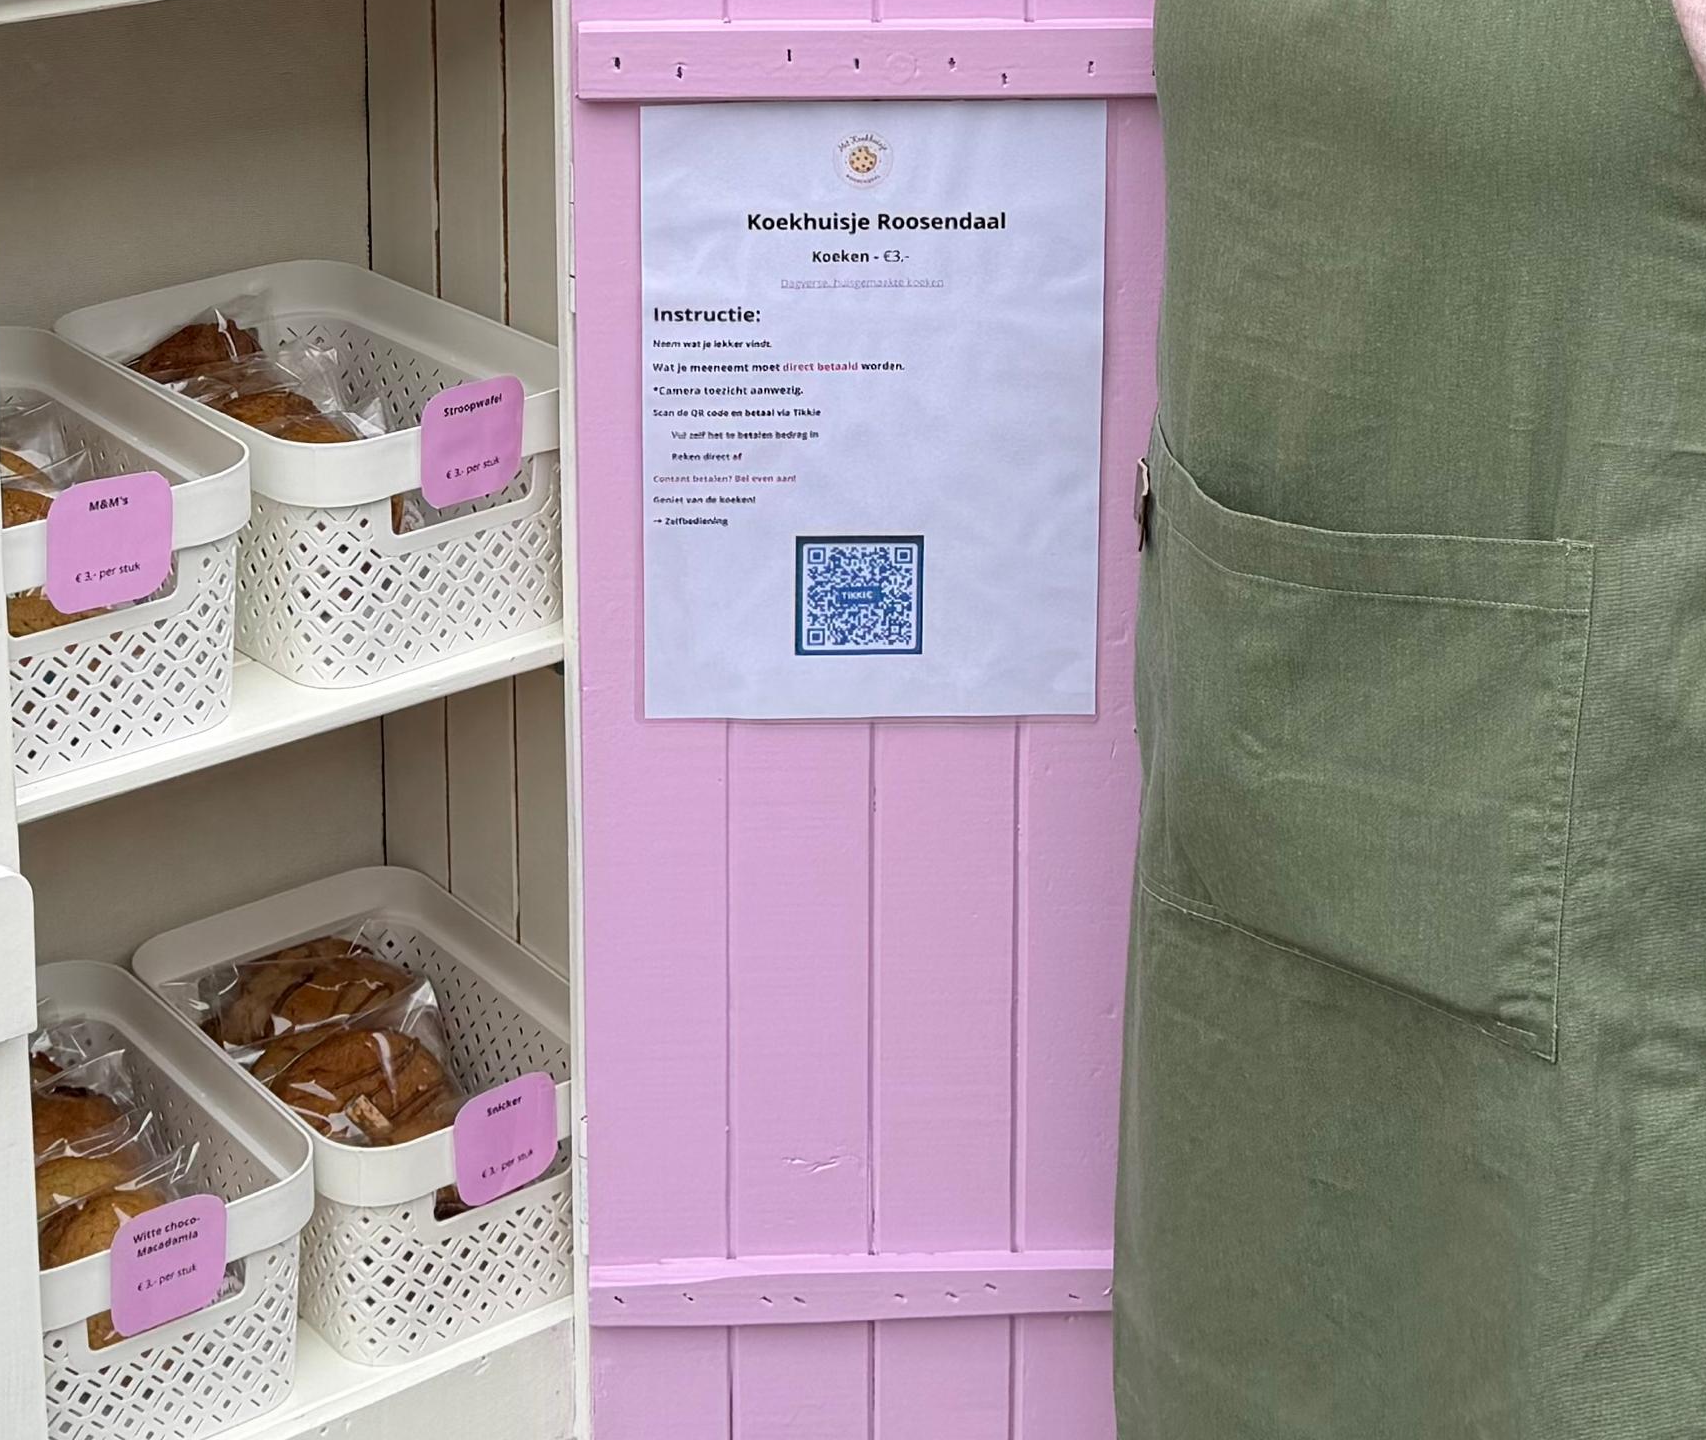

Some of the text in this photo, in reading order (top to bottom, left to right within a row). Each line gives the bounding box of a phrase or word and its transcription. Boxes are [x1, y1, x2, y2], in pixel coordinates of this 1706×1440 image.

[747, 212, 1006, 235] Koekhuisje Roosendaal
[812, 249, 870, 263] Koeken
[654, 306, 761, 323] Instructie:
[653, 340, 681, 348] Neem
[683, 340, 701, 348] wat
[702, 339, 712, 350] je
[714, 339, 744, 348] lekker
[653, 361, 906, 374] Wat je meeneemt moet direct betaald worden.
[704, 386, 748, 395] toezicht
[750, 385, 804, 396] aanwezig.
[443, 393, 503, 417] Stroopwafel
[653, 409, 675, 417] Scan
[677, 409, 688, 417] de
[691, 409, 705, 418] QR
[706, 409, 729, 417] code
[745, 409, 774, 417] betaal
[777, 409, 790, 417] via
[793, 408, 821, 417] Tikkie
[737, 431, 773, 440] betalen
[775, 430, 808, 441] bedrag
[810, 430, 819, 438] in
[466, 462, 481, 475] per
[483, 456, 500, 468] stuk
[88, 496, 129, 512] M&M's
[653, 496, 684, 504] Geniet
[686, 496, 703, 504] van
[665, 517, 729, 526] Zelfbediening
[75, 573, 82, 583] €
[99, 567, 116, 580] per
[119, 562, 141, 574] stuk
[486, 1096, 522, 1117] Snicker
[133, 1216, 201, 1244] Witte choco-
[136, 1230, 199, 1258] Macadamia
[159, 1271, 175, 1285] per
[177, 1263, 197, 1276] stuk
